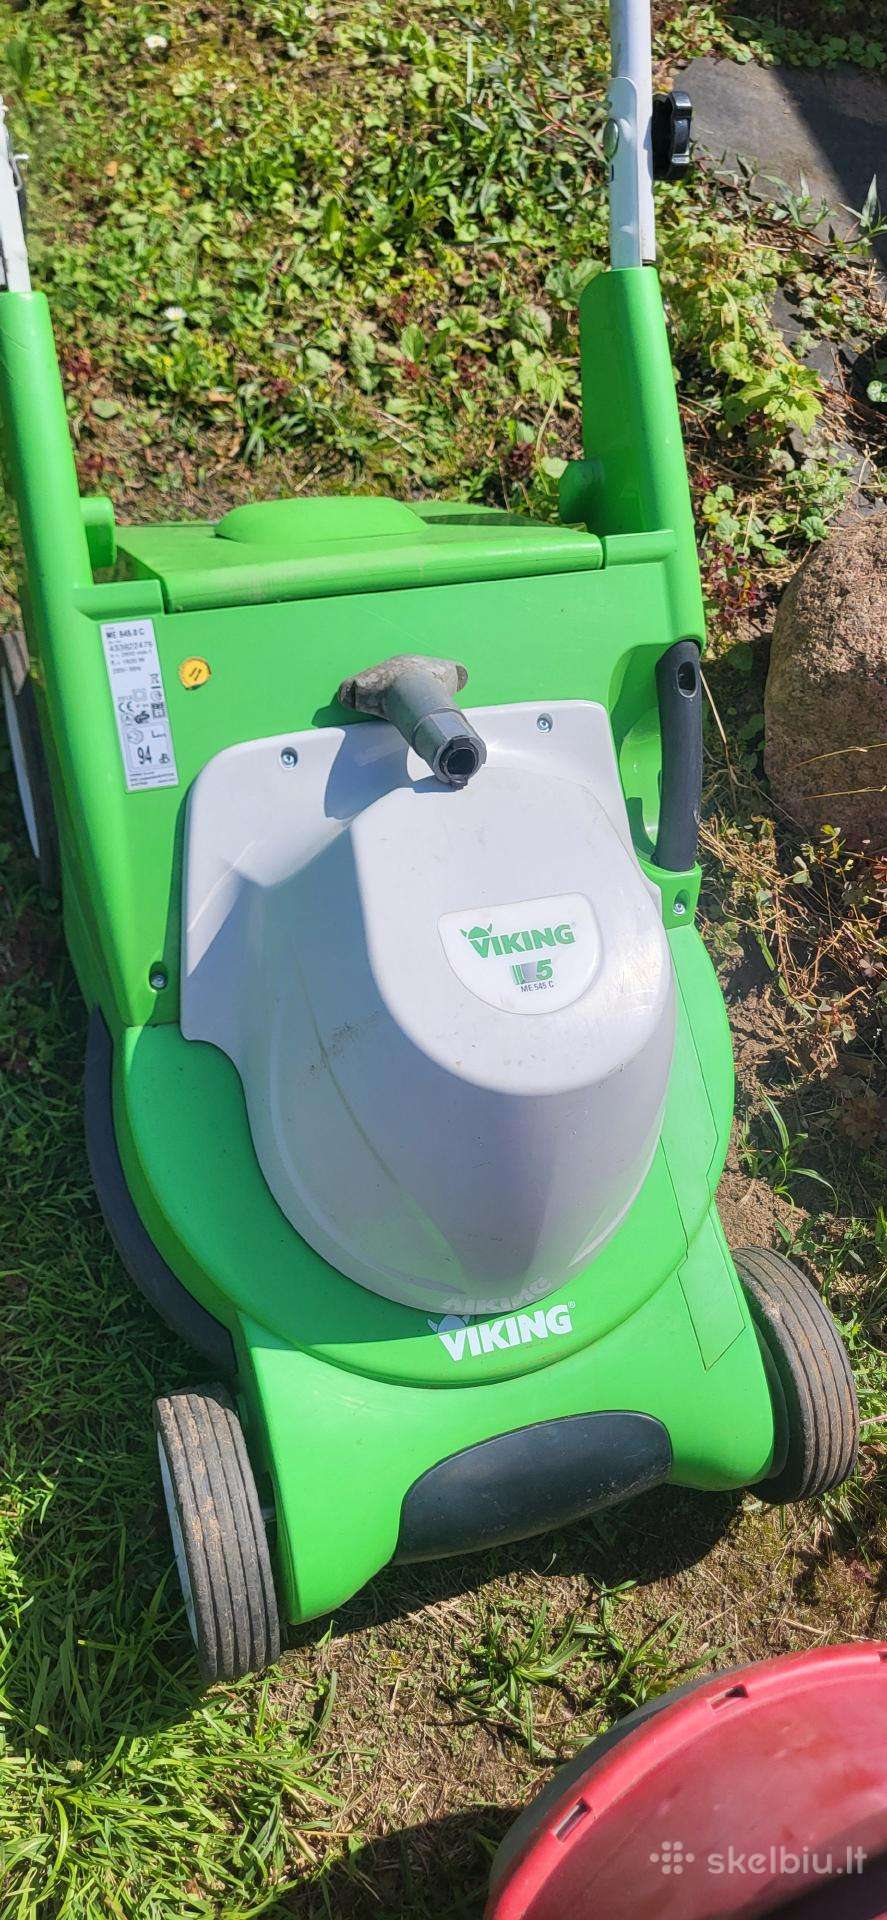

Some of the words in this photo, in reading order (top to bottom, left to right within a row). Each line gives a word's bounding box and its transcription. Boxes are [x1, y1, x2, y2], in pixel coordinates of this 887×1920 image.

[137, 745, 152, 765] 94
[469, 924, 575, 958] VIKING
[521, 985, 533, 993] ME
[534, 982, 547, 991] 545
[549, 981, 555, 989] C
